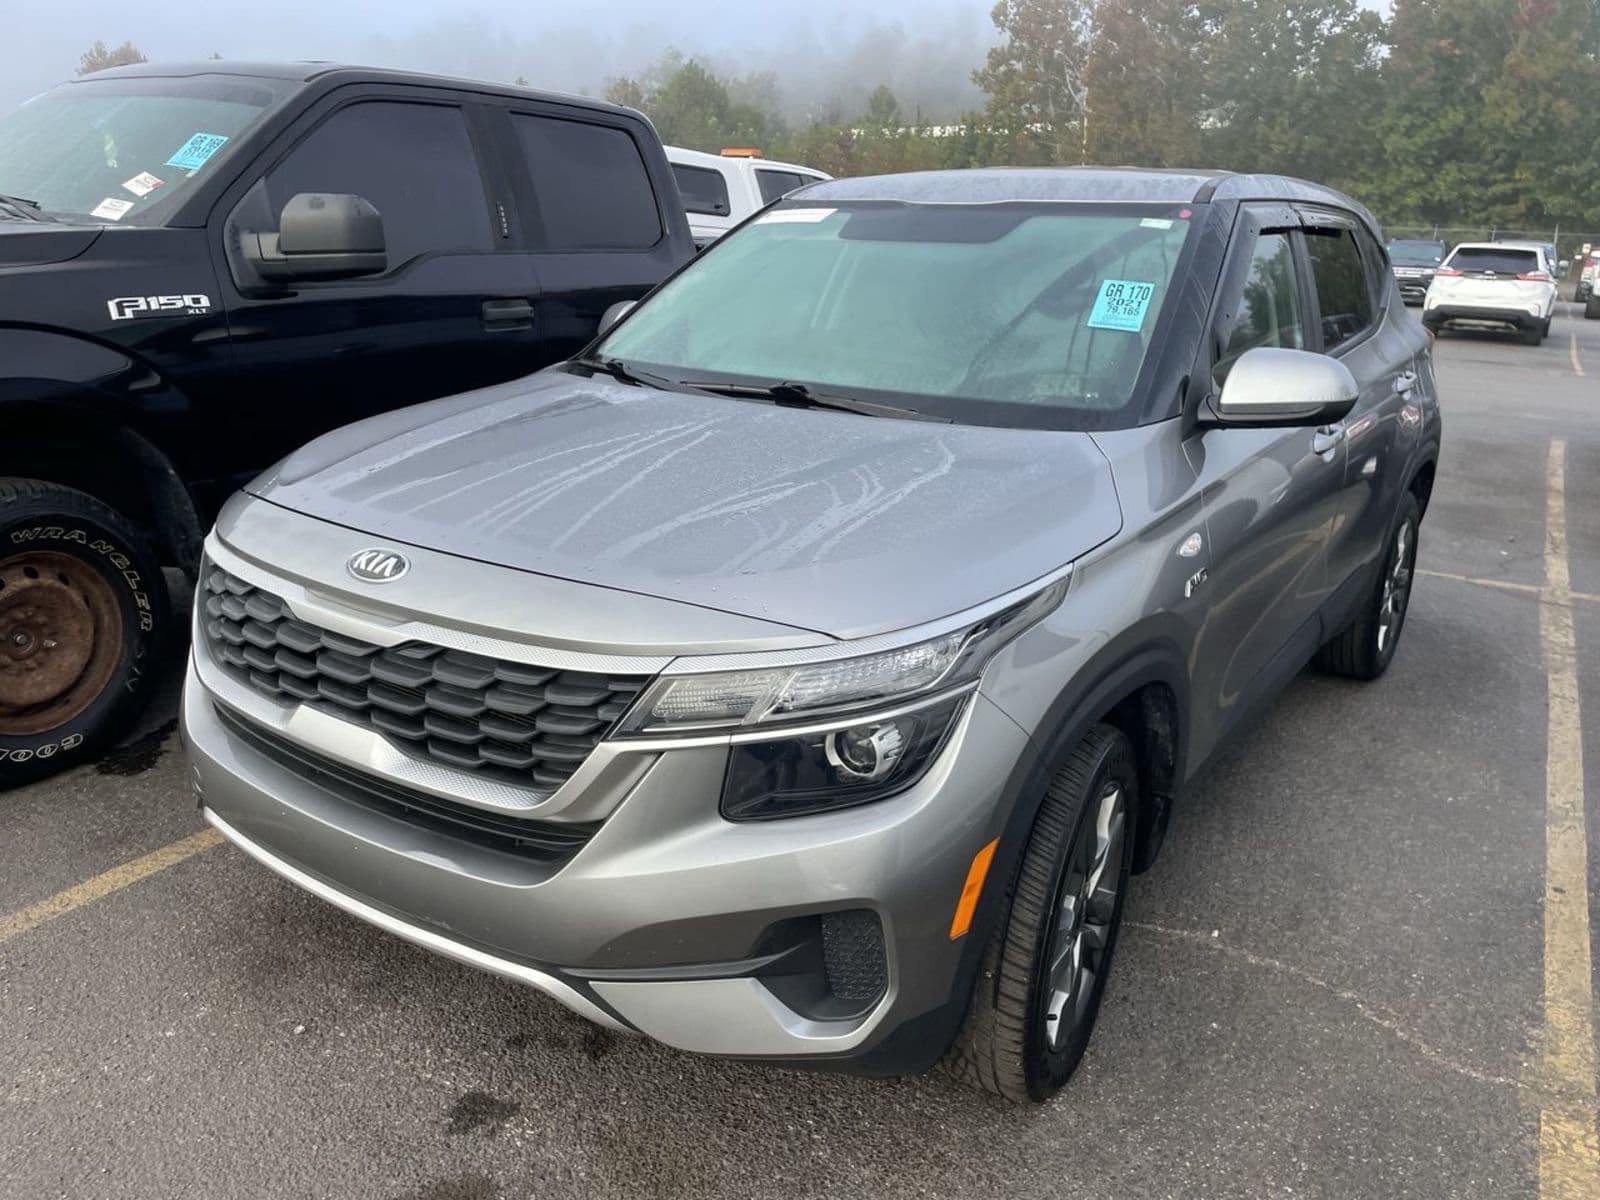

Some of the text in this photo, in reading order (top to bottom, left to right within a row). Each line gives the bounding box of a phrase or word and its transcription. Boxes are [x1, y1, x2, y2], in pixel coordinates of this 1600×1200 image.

[1105, 283, 1151, 301] GR 170
[1107, 297, 1142, 308] 2021
[107, 294, 211, 320] F150
[352, 551, 399, 577] KIA
[10, 526, 153, 632] WRANGLER
